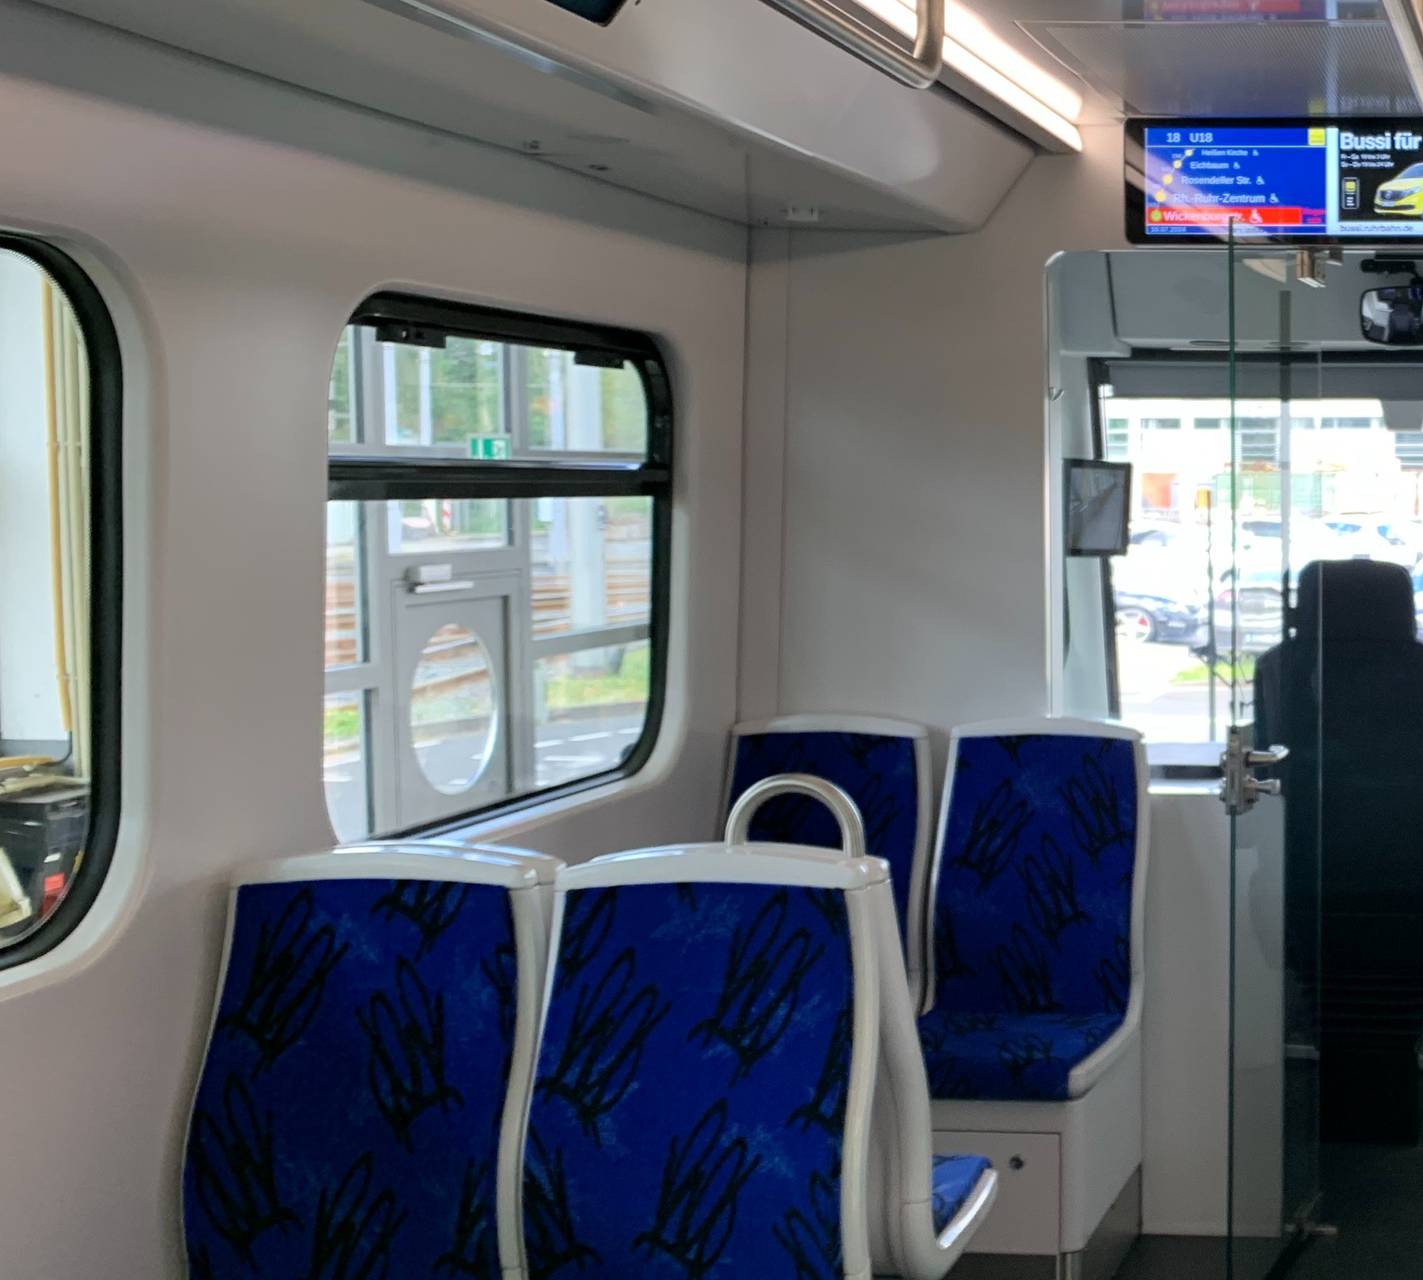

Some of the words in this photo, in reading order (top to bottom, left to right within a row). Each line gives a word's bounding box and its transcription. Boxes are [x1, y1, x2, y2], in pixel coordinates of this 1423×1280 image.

[1166, 132, 1181, 143] 18
[1189, 132, 1214, 143] U18
[1340, 131, 1392, 149] Bussi
[1394, 132, 1422, 149] für
[1236, 175, 1252, 185] Str.
